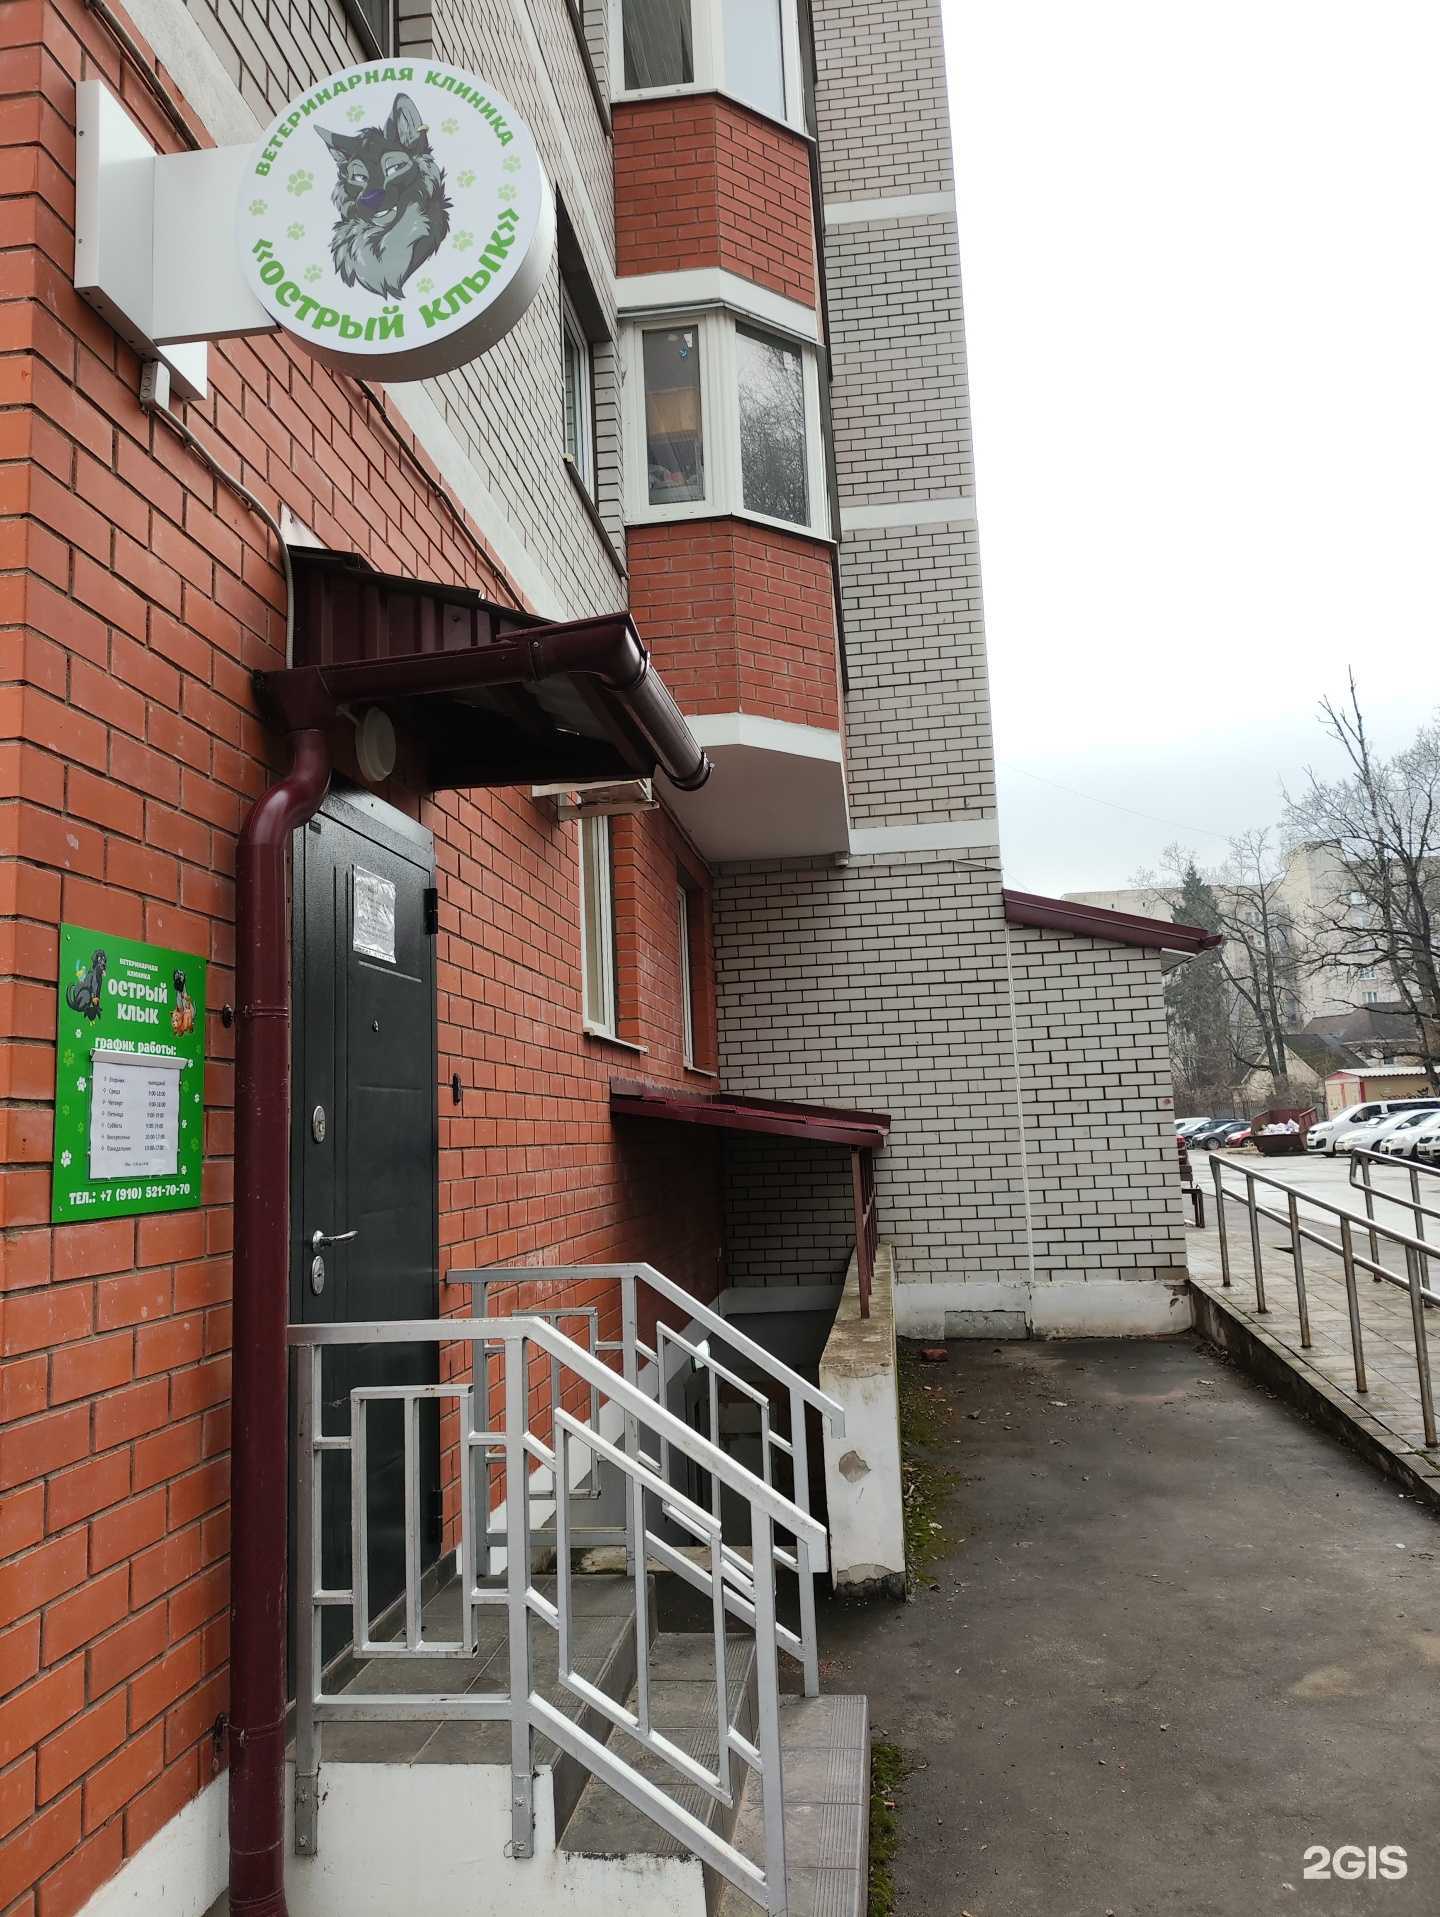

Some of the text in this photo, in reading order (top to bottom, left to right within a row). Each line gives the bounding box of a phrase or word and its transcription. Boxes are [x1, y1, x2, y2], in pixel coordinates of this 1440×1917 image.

[255, 67, 514, 177] ВЕТЕРИНАРНАЯ КЛИНИКА
[251, 208, 520, 341] «ОСТРЫЙ КЛЫК»
[107, 978, 168, 1004] ОСТРЫЙ
[117, 1003, 159, 1025] КЛЫК
[137, 1041, 177, 1056] работы:
[69, 1183, 191, 1205] ТЕЛ.: +7 (910) 521-70-70
